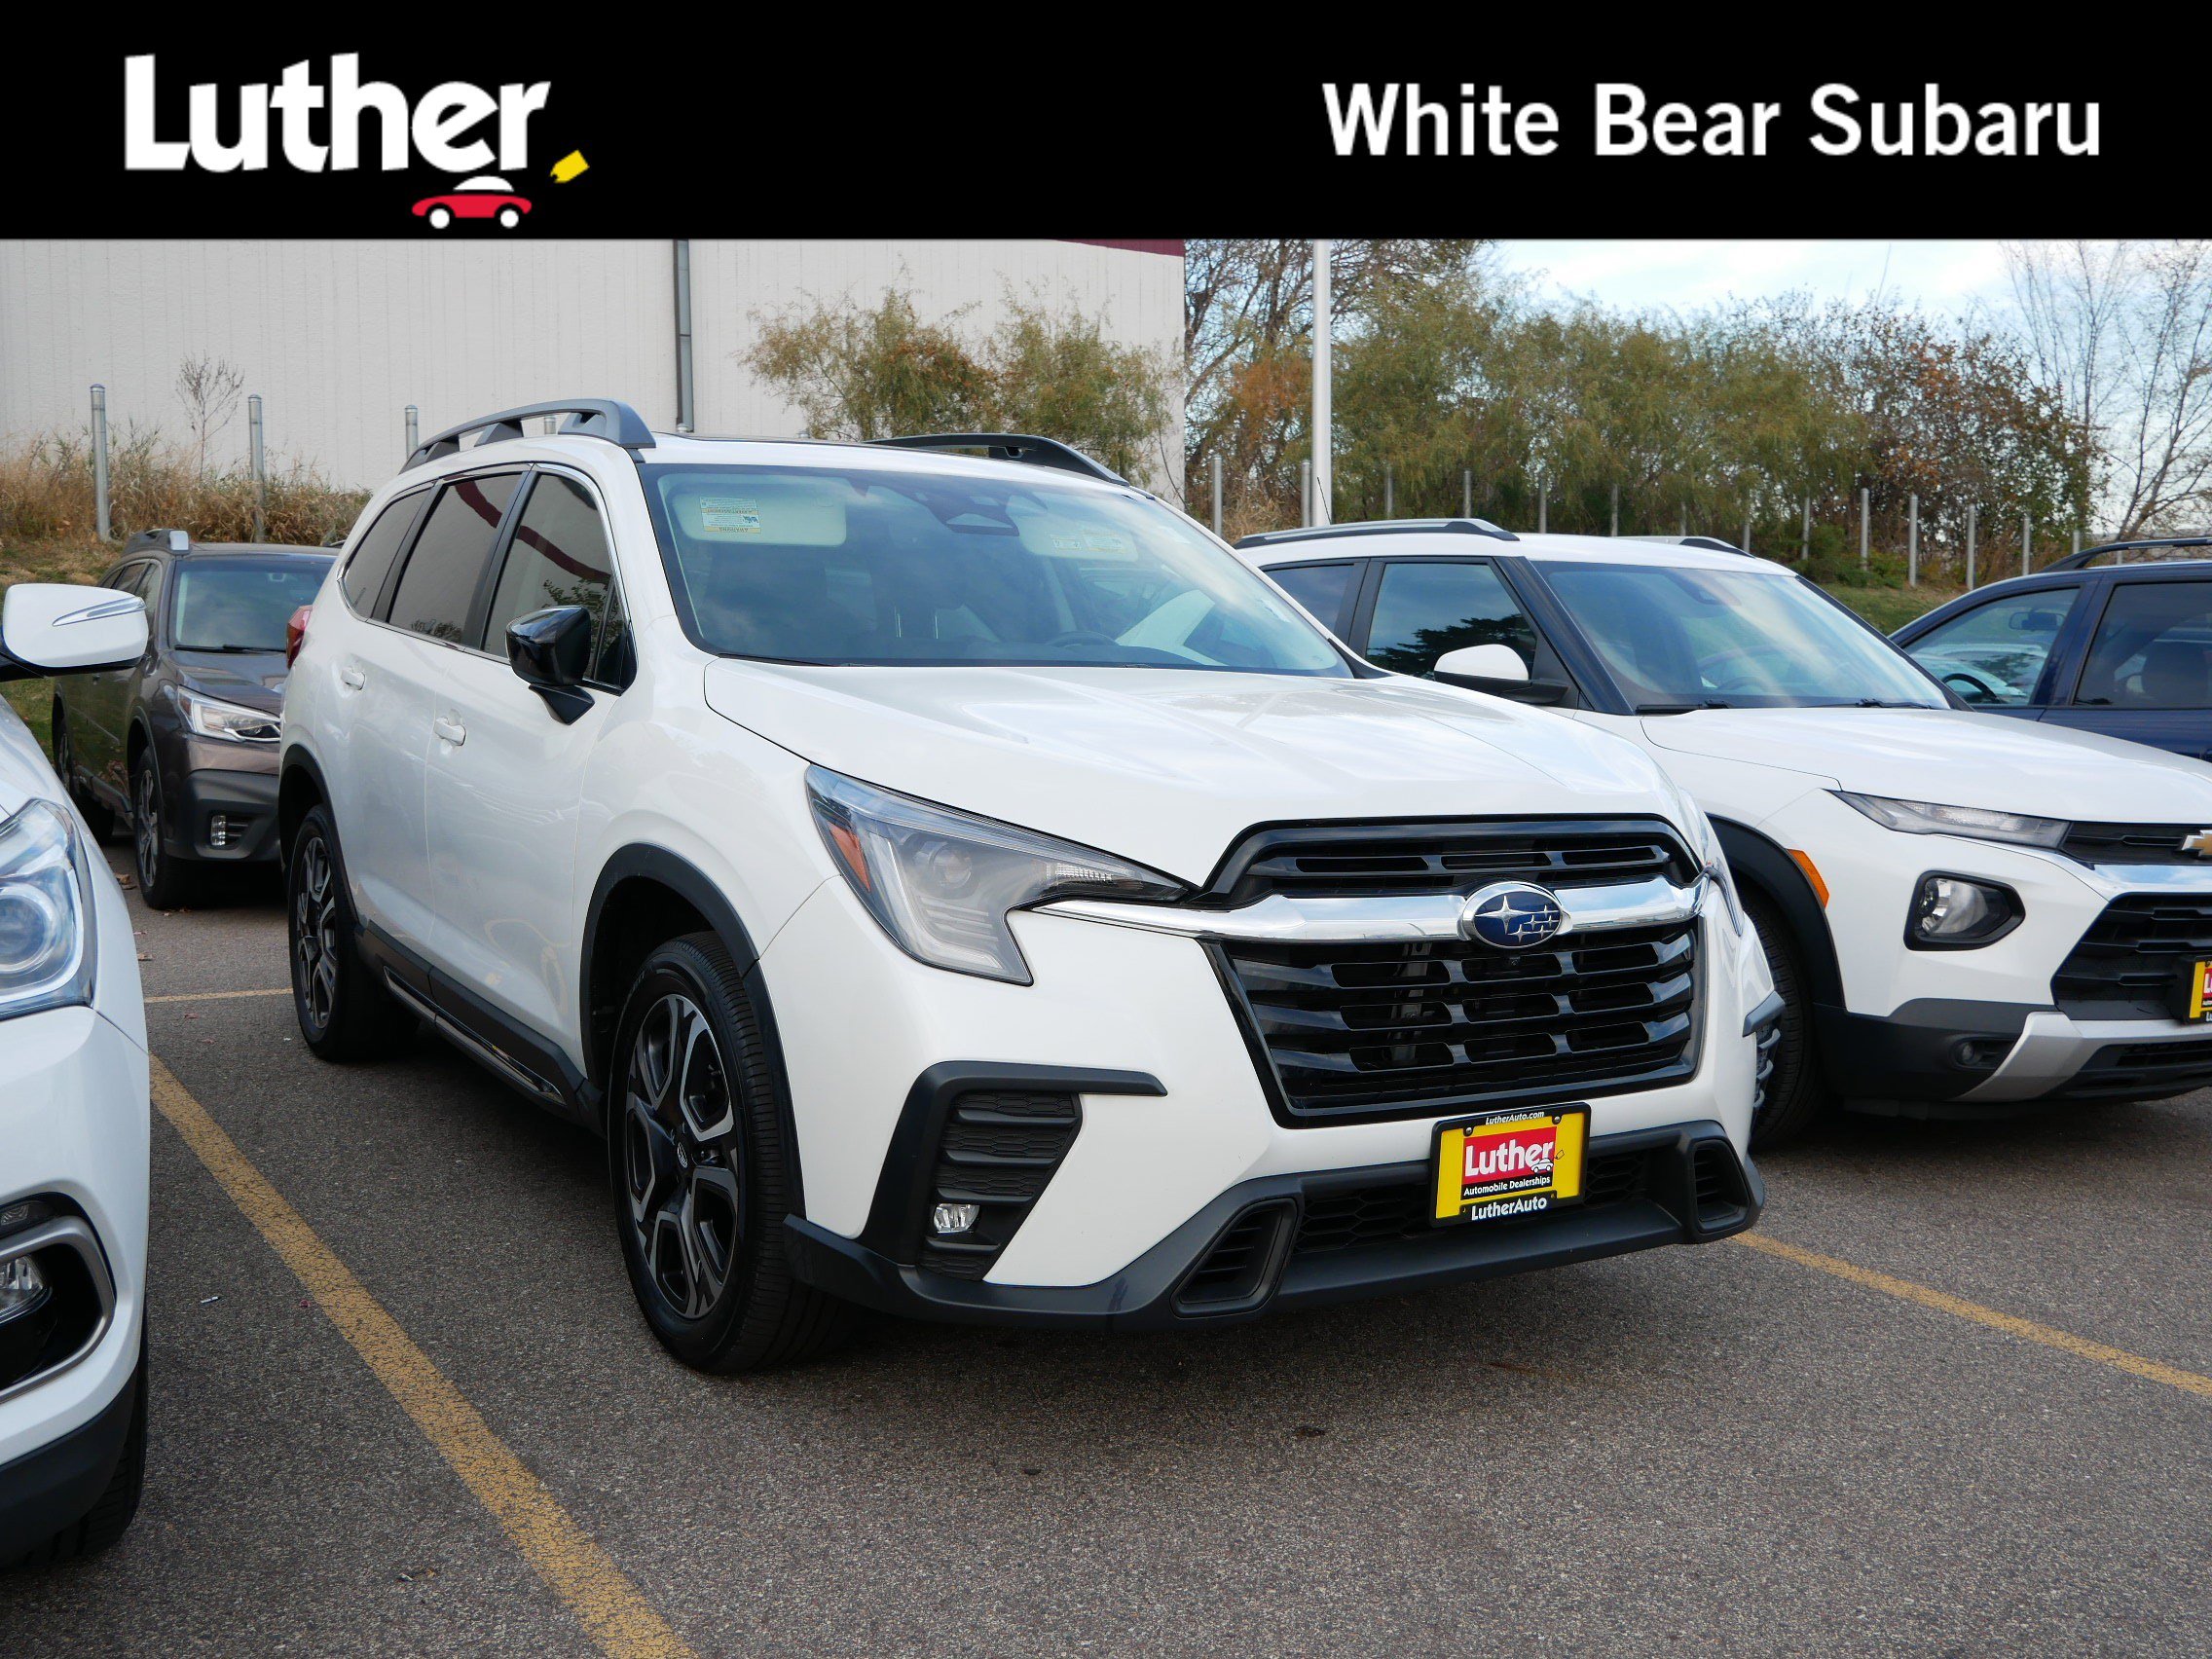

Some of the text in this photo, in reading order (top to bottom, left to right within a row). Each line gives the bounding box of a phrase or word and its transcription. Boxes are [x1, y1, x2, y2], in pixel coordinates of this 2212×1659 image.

[1486, 1112, 1545, 1124] LutherAuto.com
[1465, 1139, 1554, 1176] Luther
[1463, 1176, 1550, 1196] Automobile Dealerships
[1472, 1197, 1547, 1220] LutherAuto
